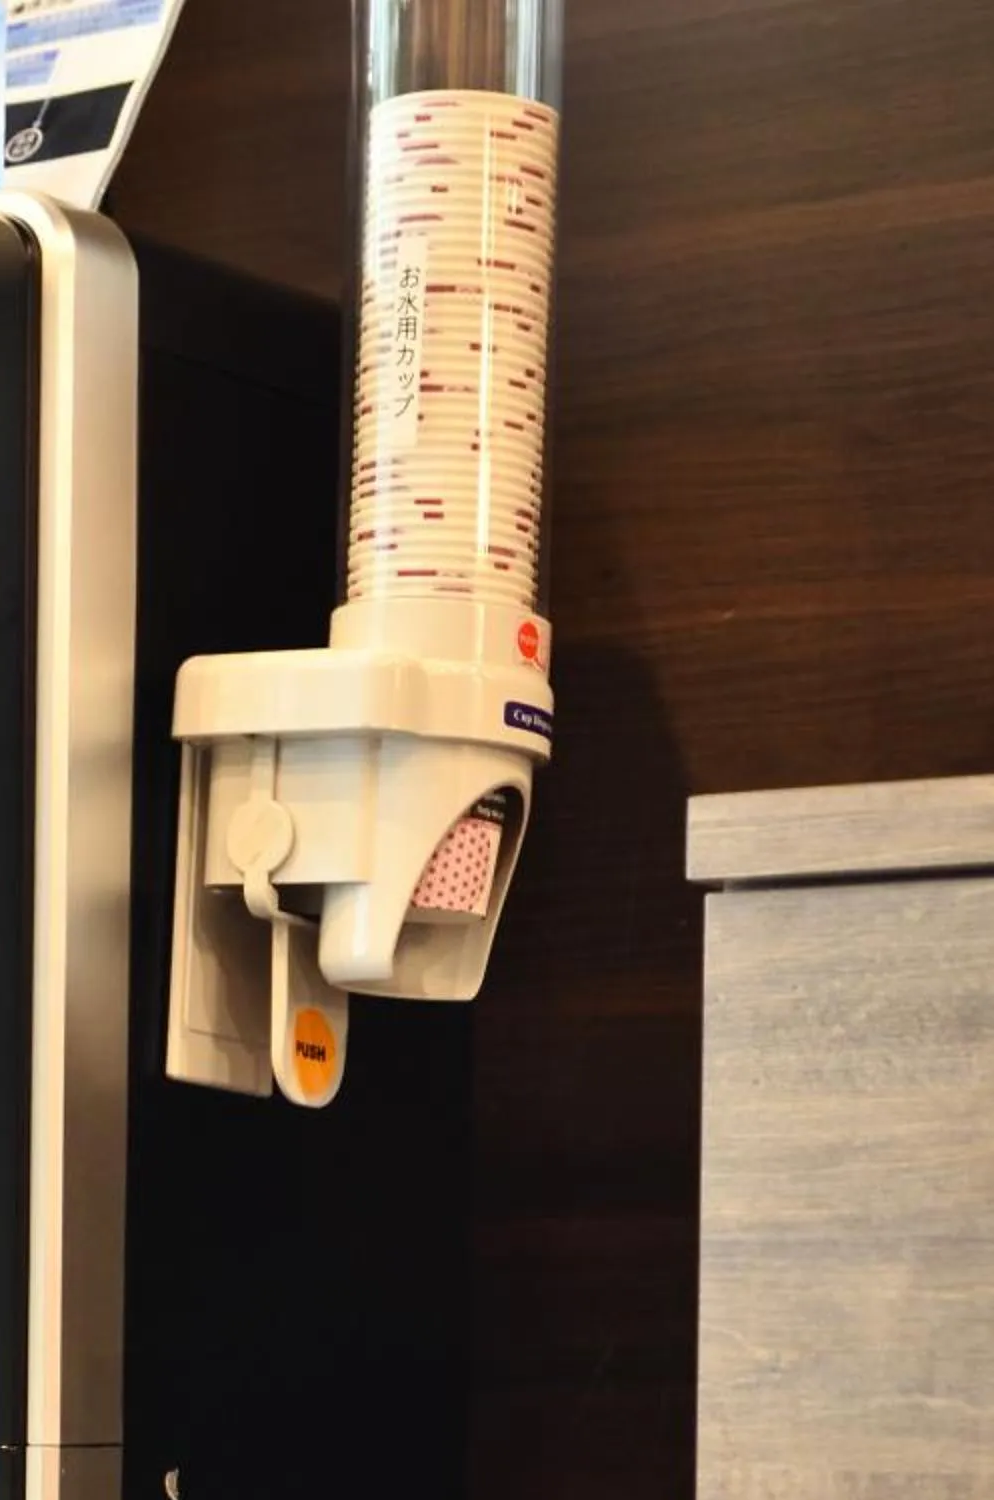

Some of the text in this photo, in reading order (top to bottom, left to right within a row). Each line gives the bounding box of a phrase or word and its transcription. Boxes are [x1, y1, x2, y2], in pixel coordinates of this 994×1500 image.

[394, 266, 421, 418] お水用カップ
[296, 1039, 327, 1063] PUSH
